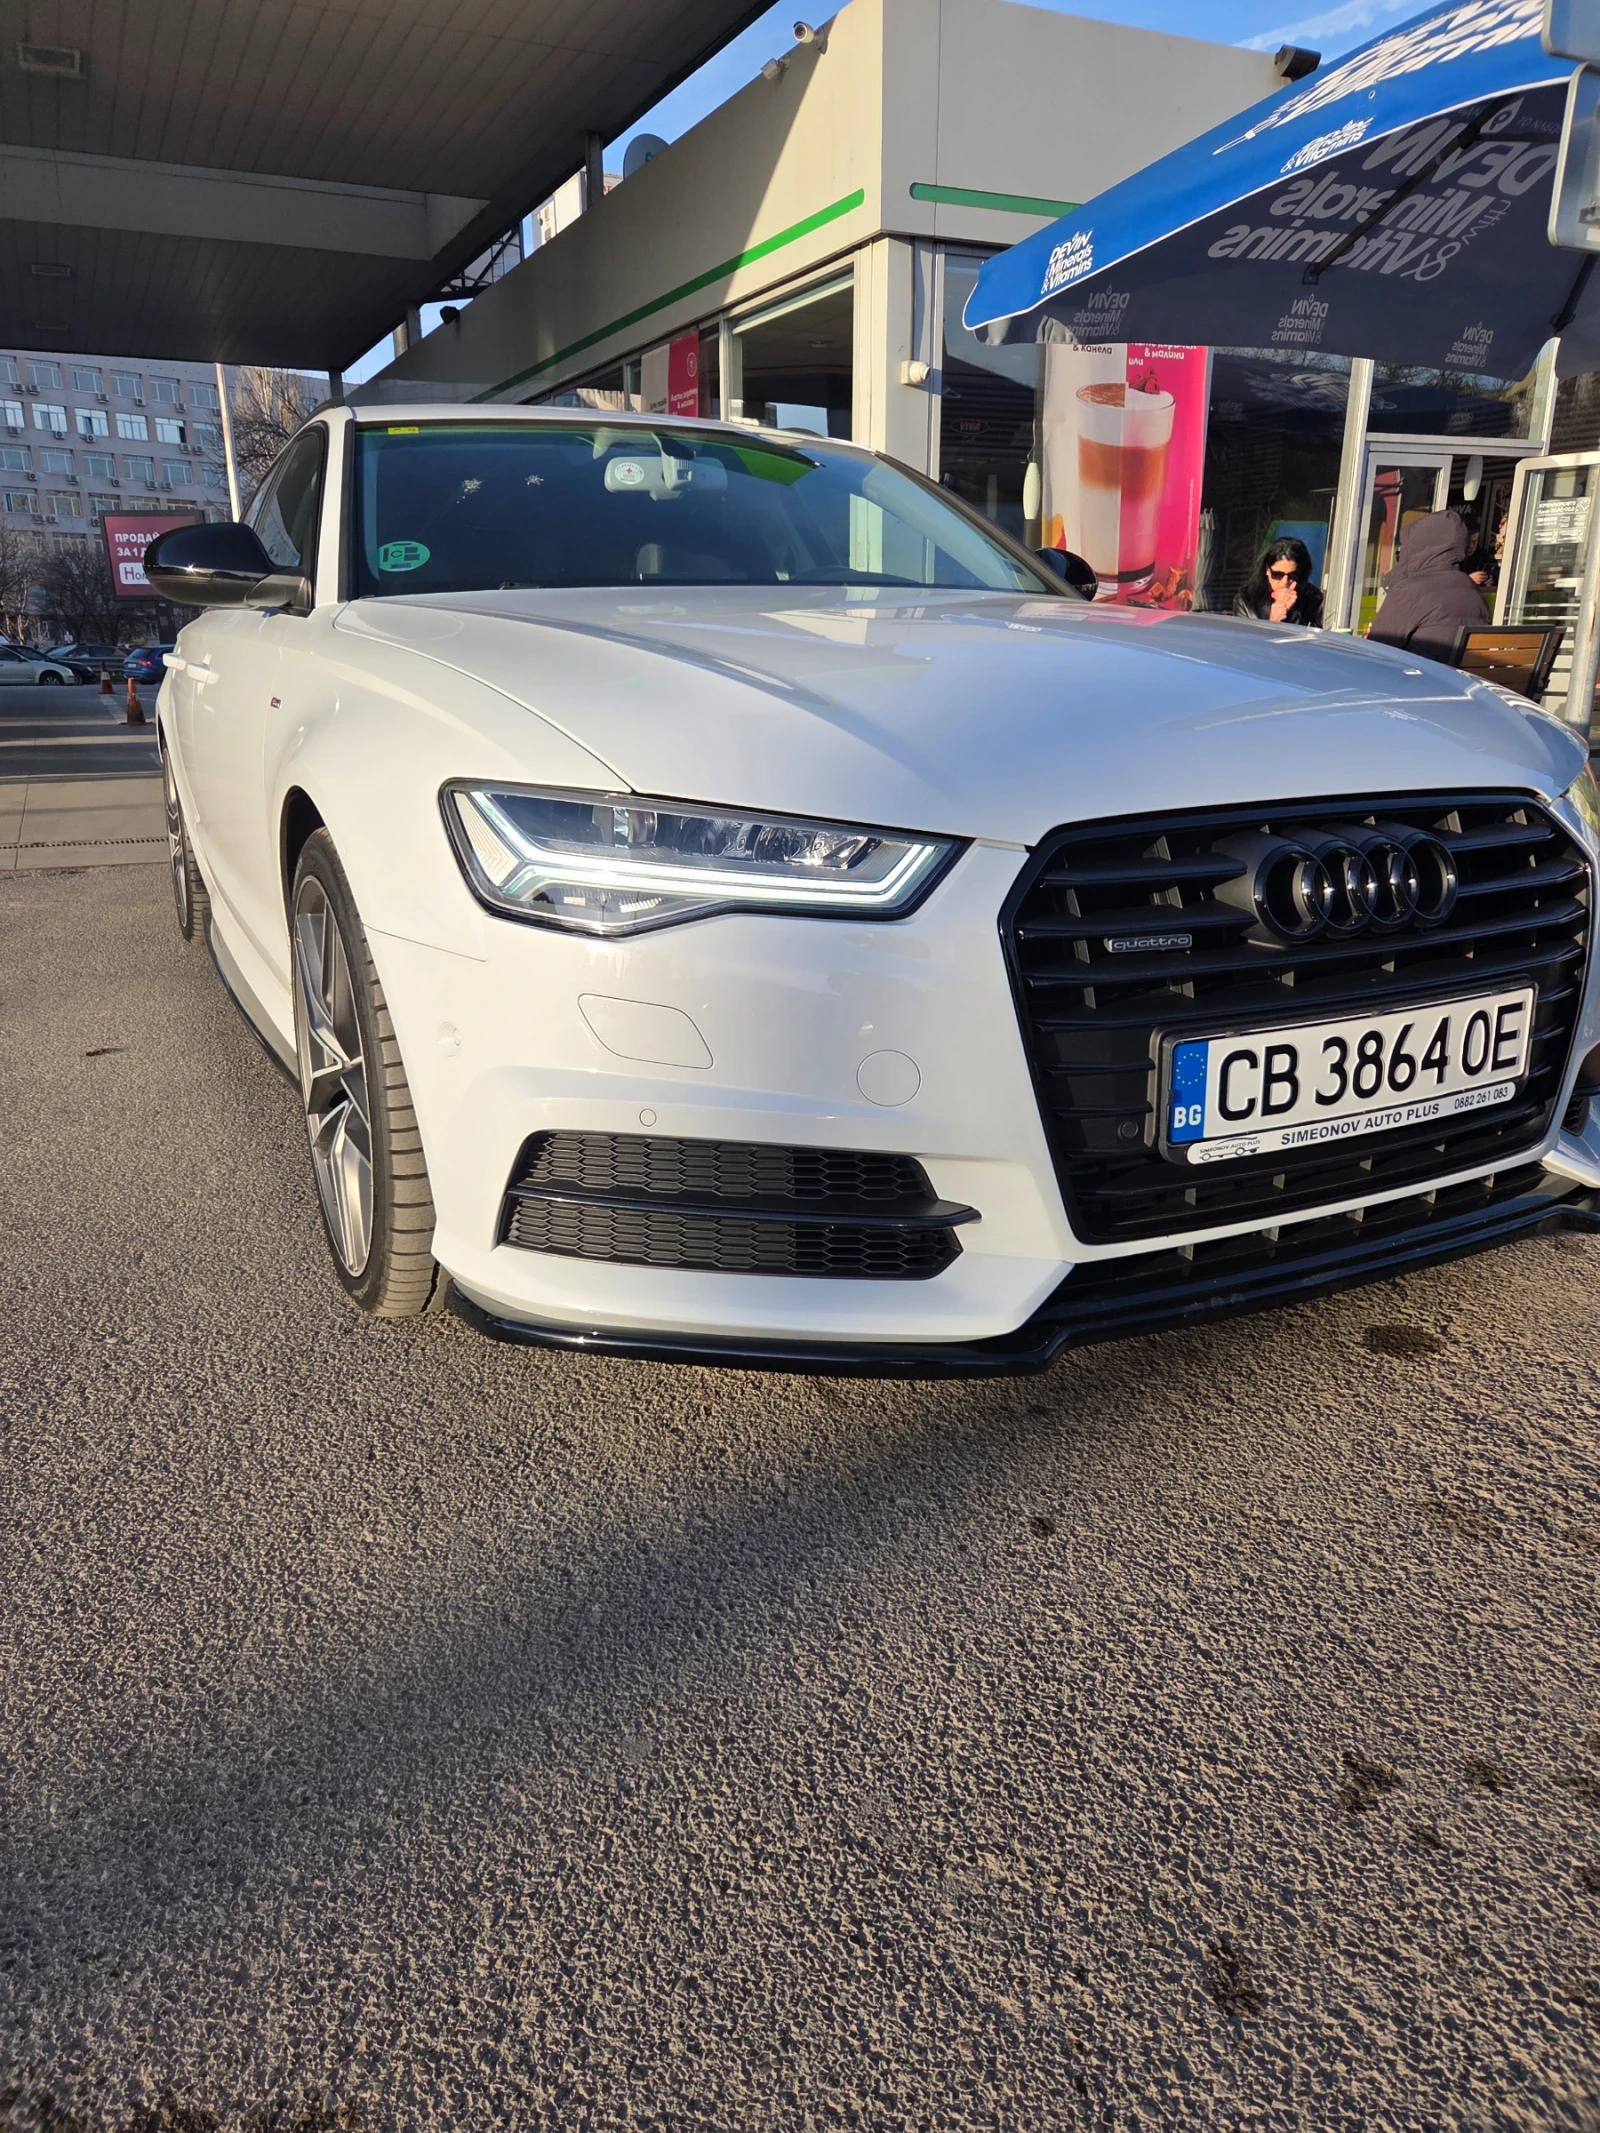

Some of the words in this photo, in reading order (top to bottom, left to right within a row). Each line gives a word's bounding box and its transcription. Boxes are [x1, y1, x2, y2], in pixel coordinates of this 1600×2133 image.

[1049, 230, 1093, 265] DEVIN
[1049, 243, 1093, 278] Minerals
[1114, 937, 1189, 951] quattro
[1217, 1043, 1299, 1121] CB
[1314, 1015, 1450, 1106] 3864
[1461, 1000, 1525, 1076] OE
[1174, 1104, 1202, 1128] BG
[1281, 1120, 1361, 1146] SIMEONOV
[1364, 1111, 1402, 1130] AUTO
[1406, 1103, 1440, 1121] PLUS
[1476, 1090, 1491, 1104] 261
[1200, 1144, 1230, 1154] SIMEONOV
[1247, 1139, 1261, 1147] PLUS
